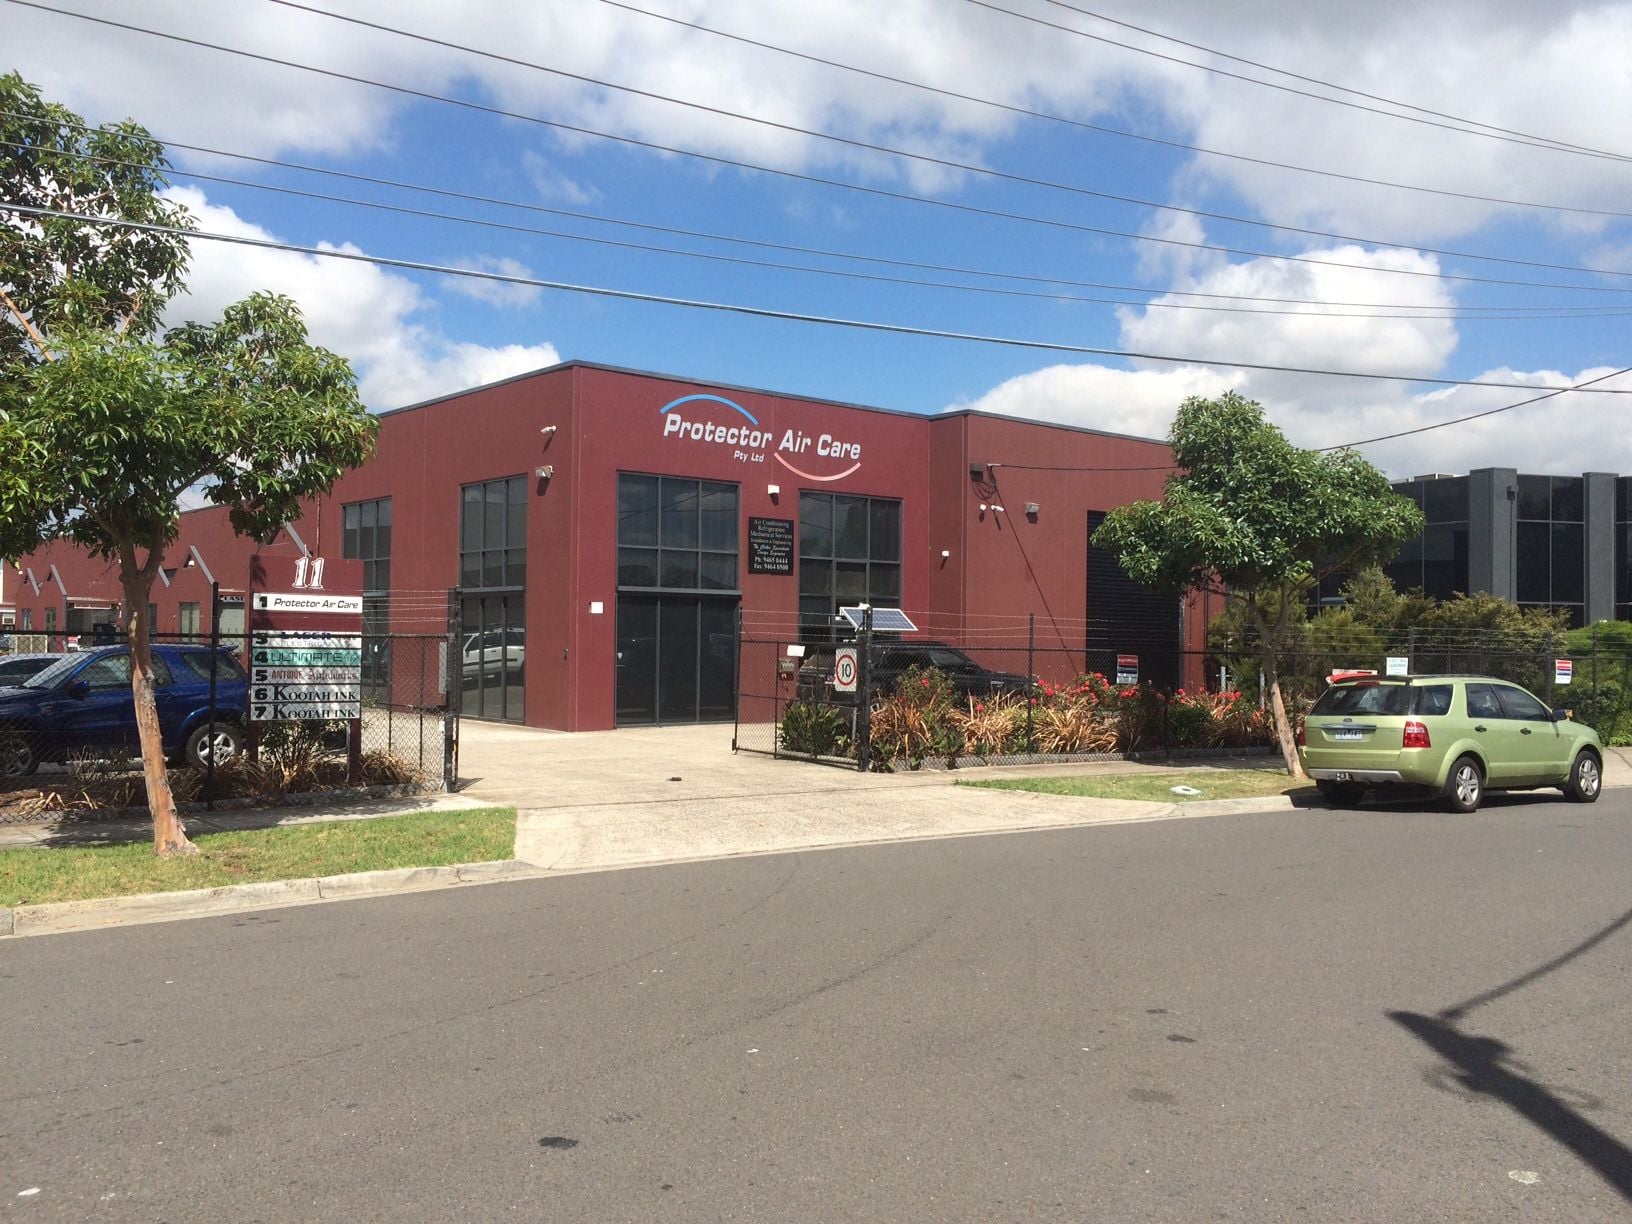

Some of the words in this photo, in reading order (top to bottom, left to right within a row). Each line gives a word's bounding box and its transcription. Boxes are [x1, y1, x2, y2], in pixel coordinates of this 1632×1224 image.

[663, 413, 773, 448] Protector
[778, 429, 812, 453] Air
[817, 434, 861, 460] Care
[733, 450, 748, 462] Pty
[750, 452, 764, 463] Ltd
[291, 556, 325, 590] 11
[259, 596, 268, 608] 1
[273, 598, 320, 608] Protector
[321, 599, 336, 608] Air
[337, 600, 359, 609] Care
[255, 651, 269, 663] 4
[270, 652, 342, 662] ULTIMATE
[255, 669, 268, 682] 5
[271, 670, 302, 680] ANTIQUE
[841, 663, 851, 678] 10
[254, 688, 268, 701] 6
[273, 685, 330, 701] KOOTAH
[335, 691, 356, 700] INK
[254, 706, 267, 718] 7
[273, 704, 330, 720] KOOTAH
[334, 709, 356, 718] INK
